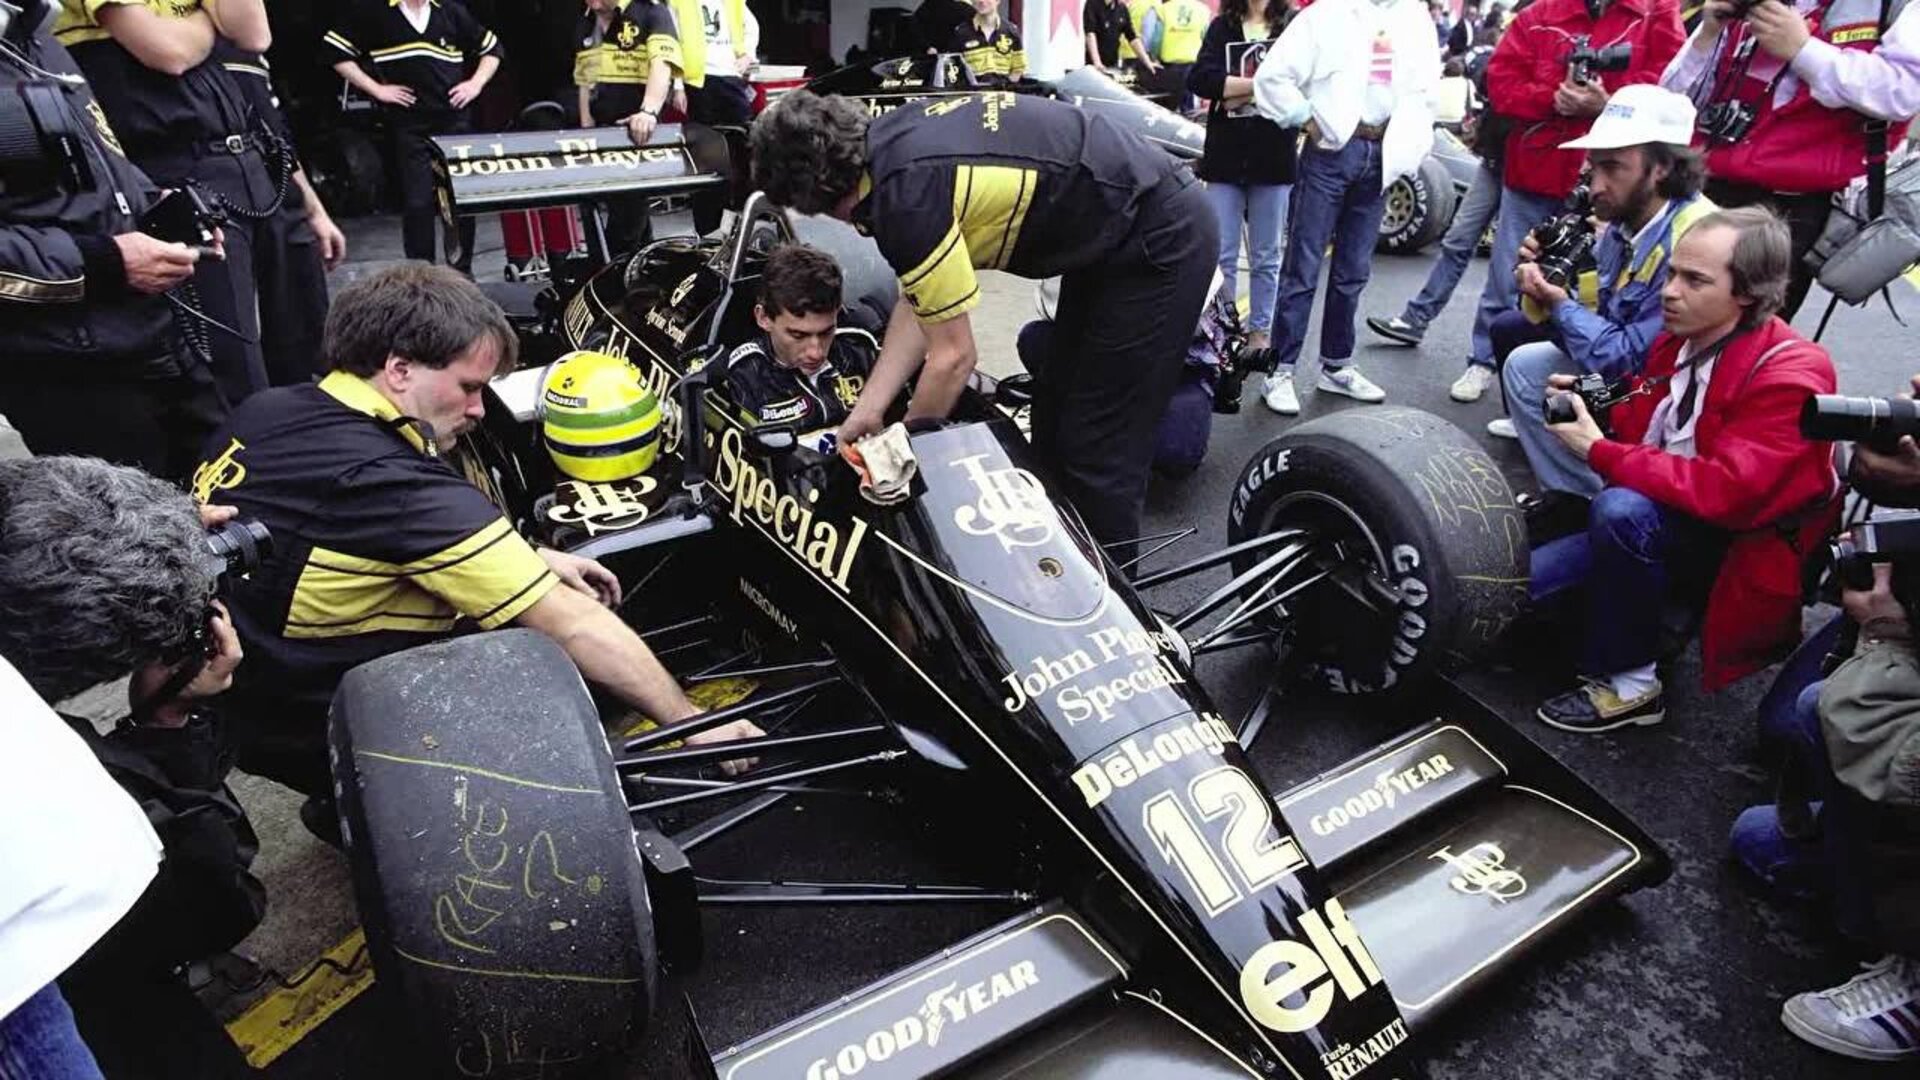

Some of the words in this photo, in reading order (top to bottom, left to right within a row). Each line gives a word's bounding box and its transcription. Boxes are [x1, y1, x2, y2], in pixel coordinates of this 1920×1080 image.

[449, 143, 555, 177] John
[556, 136, 681, 170] Player
[715, 427, 868, 594] Special
[1232, 449, 1292, 527] EAGLE
[1001, 648, 1098, 713] John
[1056, 655, 1186, 727] Special
[1310, 753, 1455, 837] GOODYEAR
[1142, 763, 1309, 919] 12
[1239, 897, 1384, 1034] elf
[806, 960, 1041, 1080] GOODYEAR
[1320, 1042, 1351, 1066] Turbo
[1325, 1017, 1409, 1080] RENAULT
